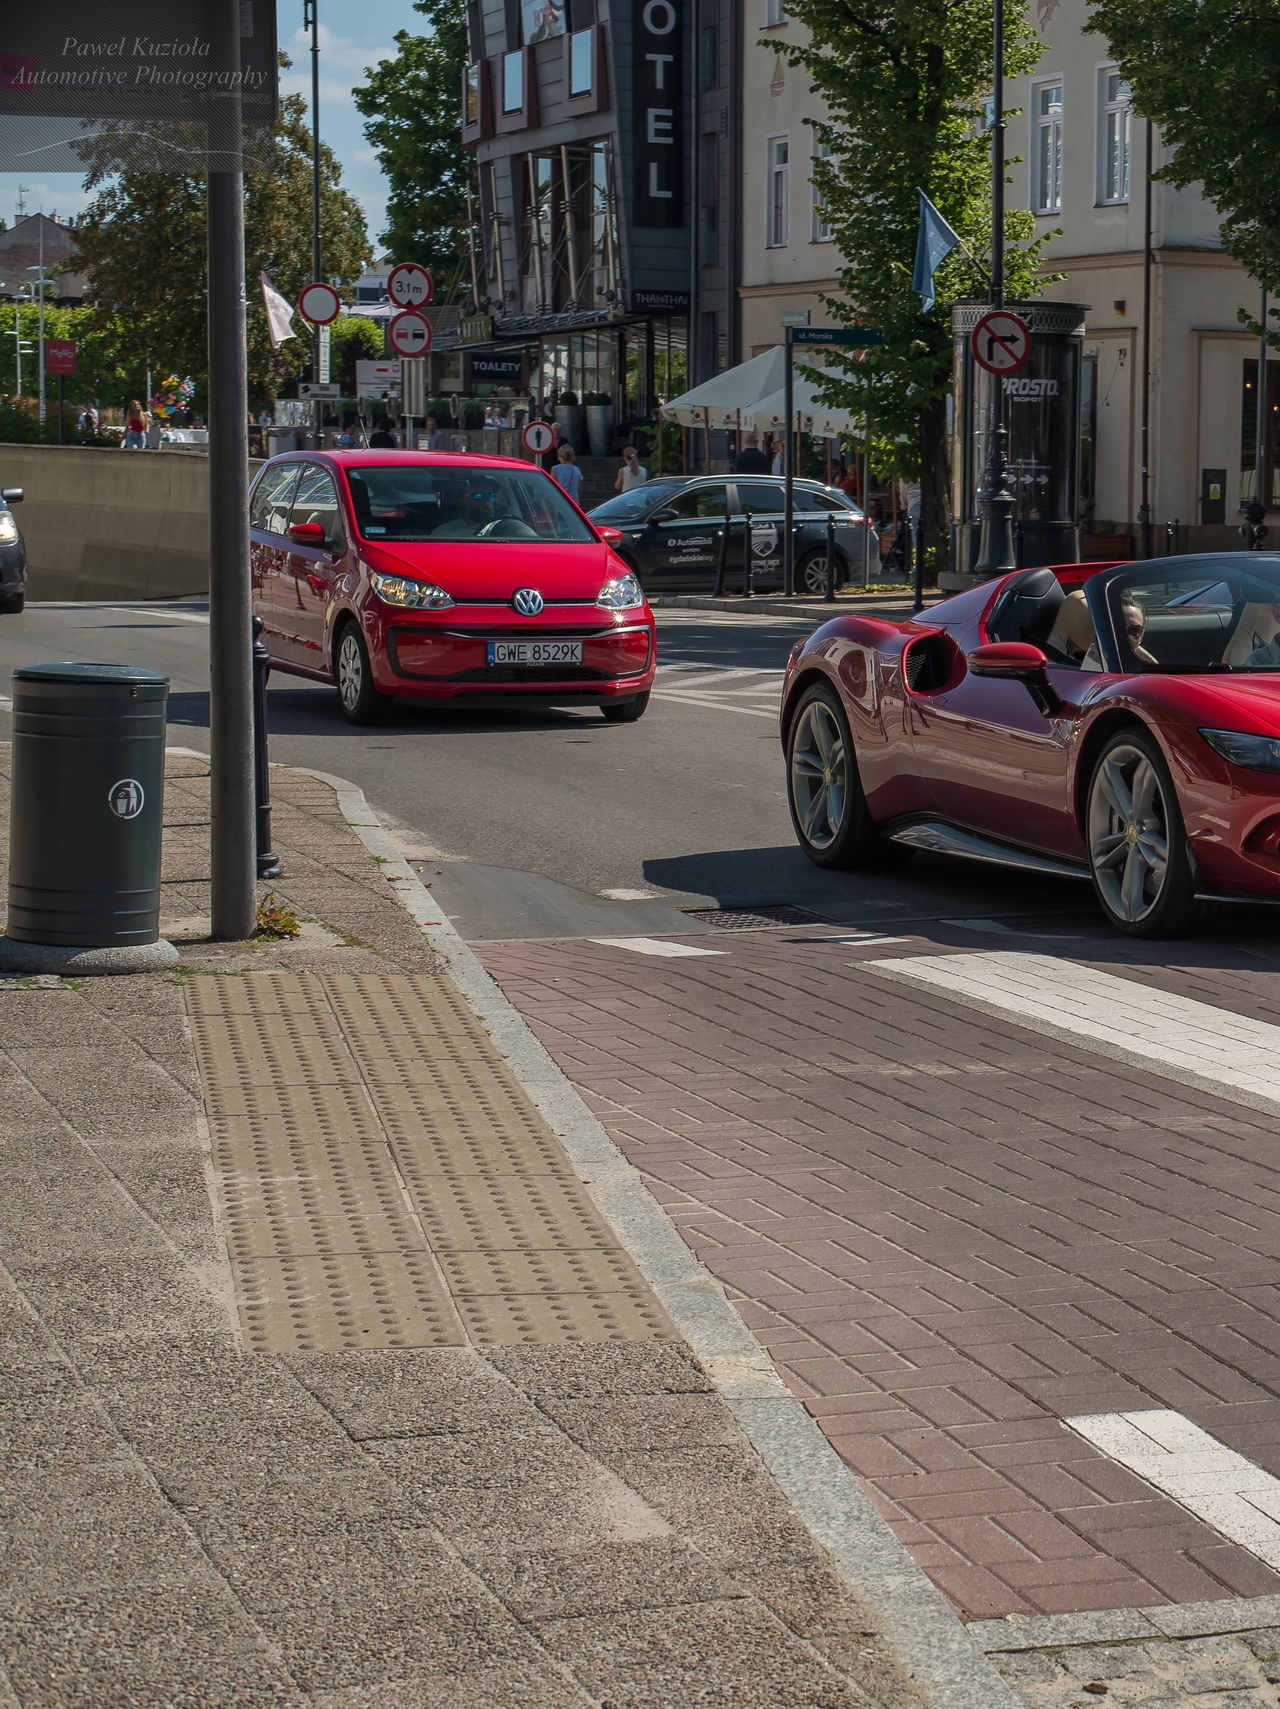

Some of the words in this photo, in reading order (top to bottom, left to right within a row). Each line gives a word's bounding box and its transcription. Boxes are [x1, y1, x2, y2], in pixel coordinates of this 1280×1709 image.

[808, 332, 833, 340] Morska
[472, 361, 521, 372] TOALETY
[496, 644, 527, 661] GWE
[532, 644, 580, 661] 8529K
